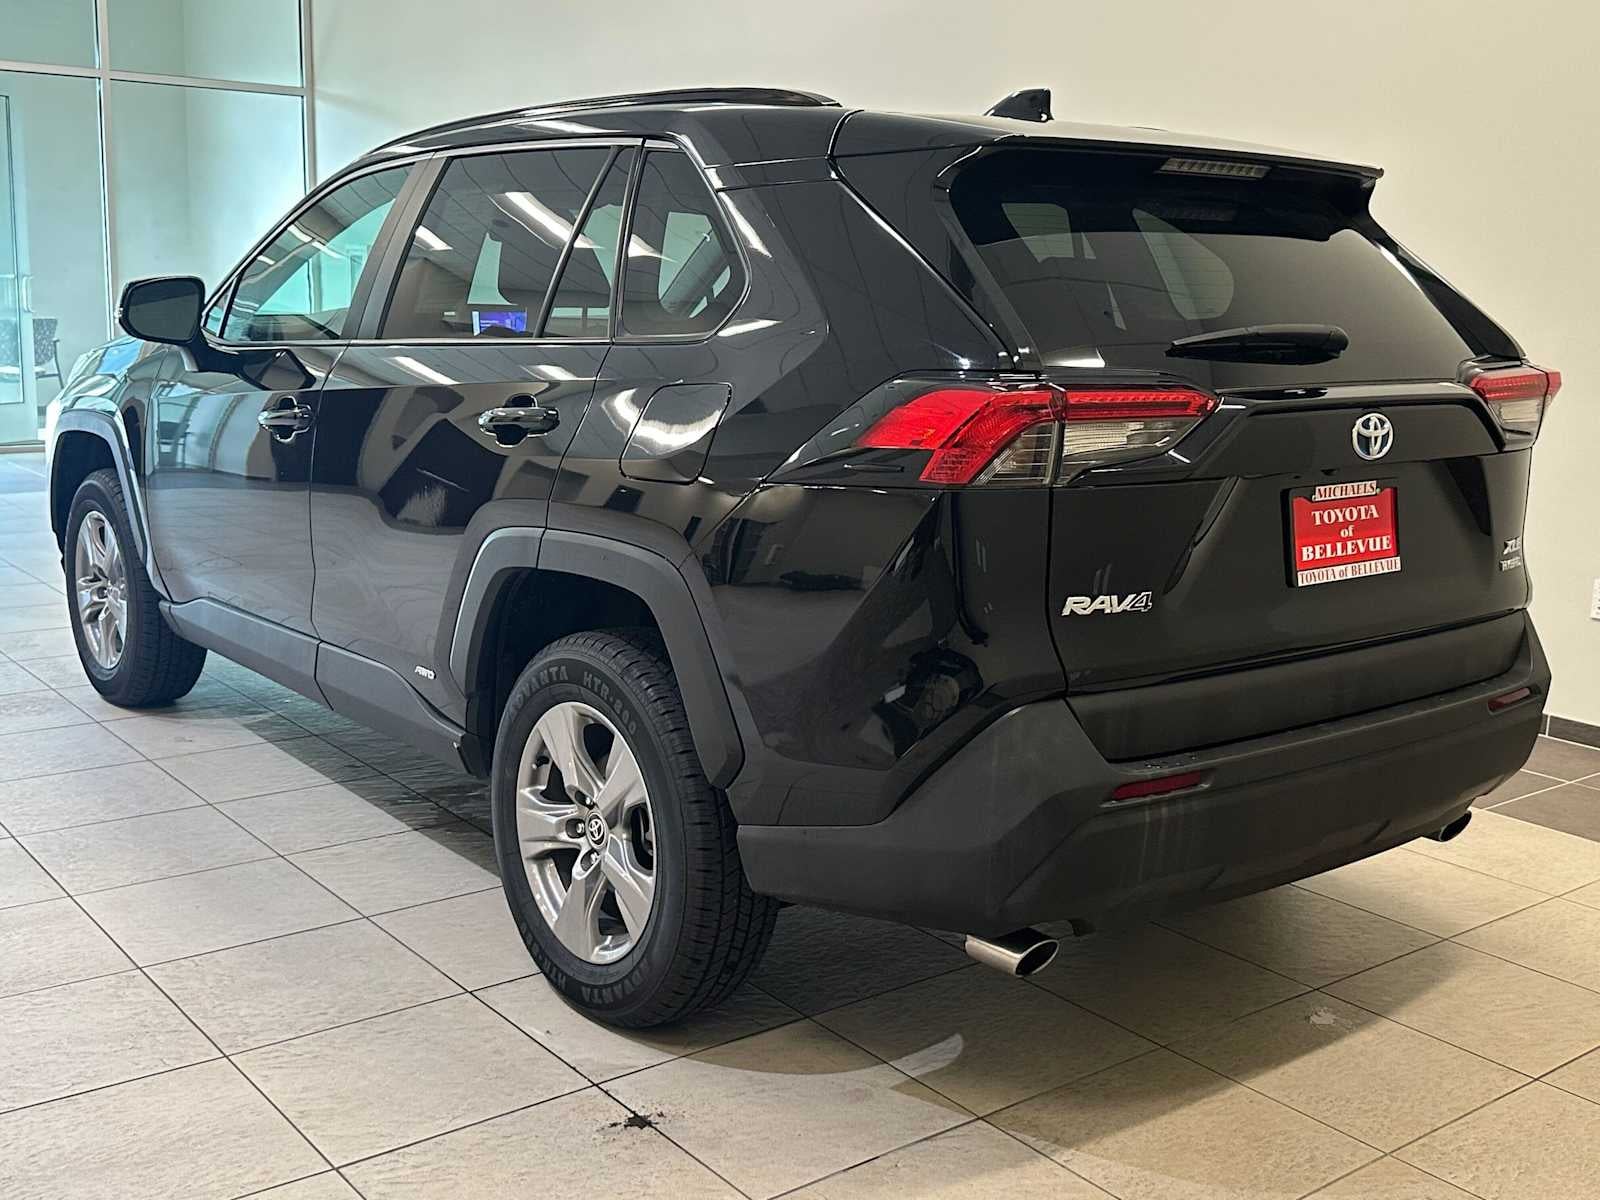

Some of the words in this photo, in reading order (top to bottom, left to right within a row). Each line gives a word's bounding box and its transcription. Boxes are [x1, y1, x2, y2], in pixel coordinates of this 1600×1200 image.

[1316, 481, 1376, 499] MICHAELS
[1311, 504, 1379, 526] TOYOTA
[1340, 525, 1354, 538] of
[1301, 535, 1392, 562] BELLEVUE
[1299, 567, 1336, 585] TOYOTA
[1338, 567, 1349, 579] of
[1351, 558, 1400, 576] BELLEVUE
[1061, 591, 1153, 616] RAV4
